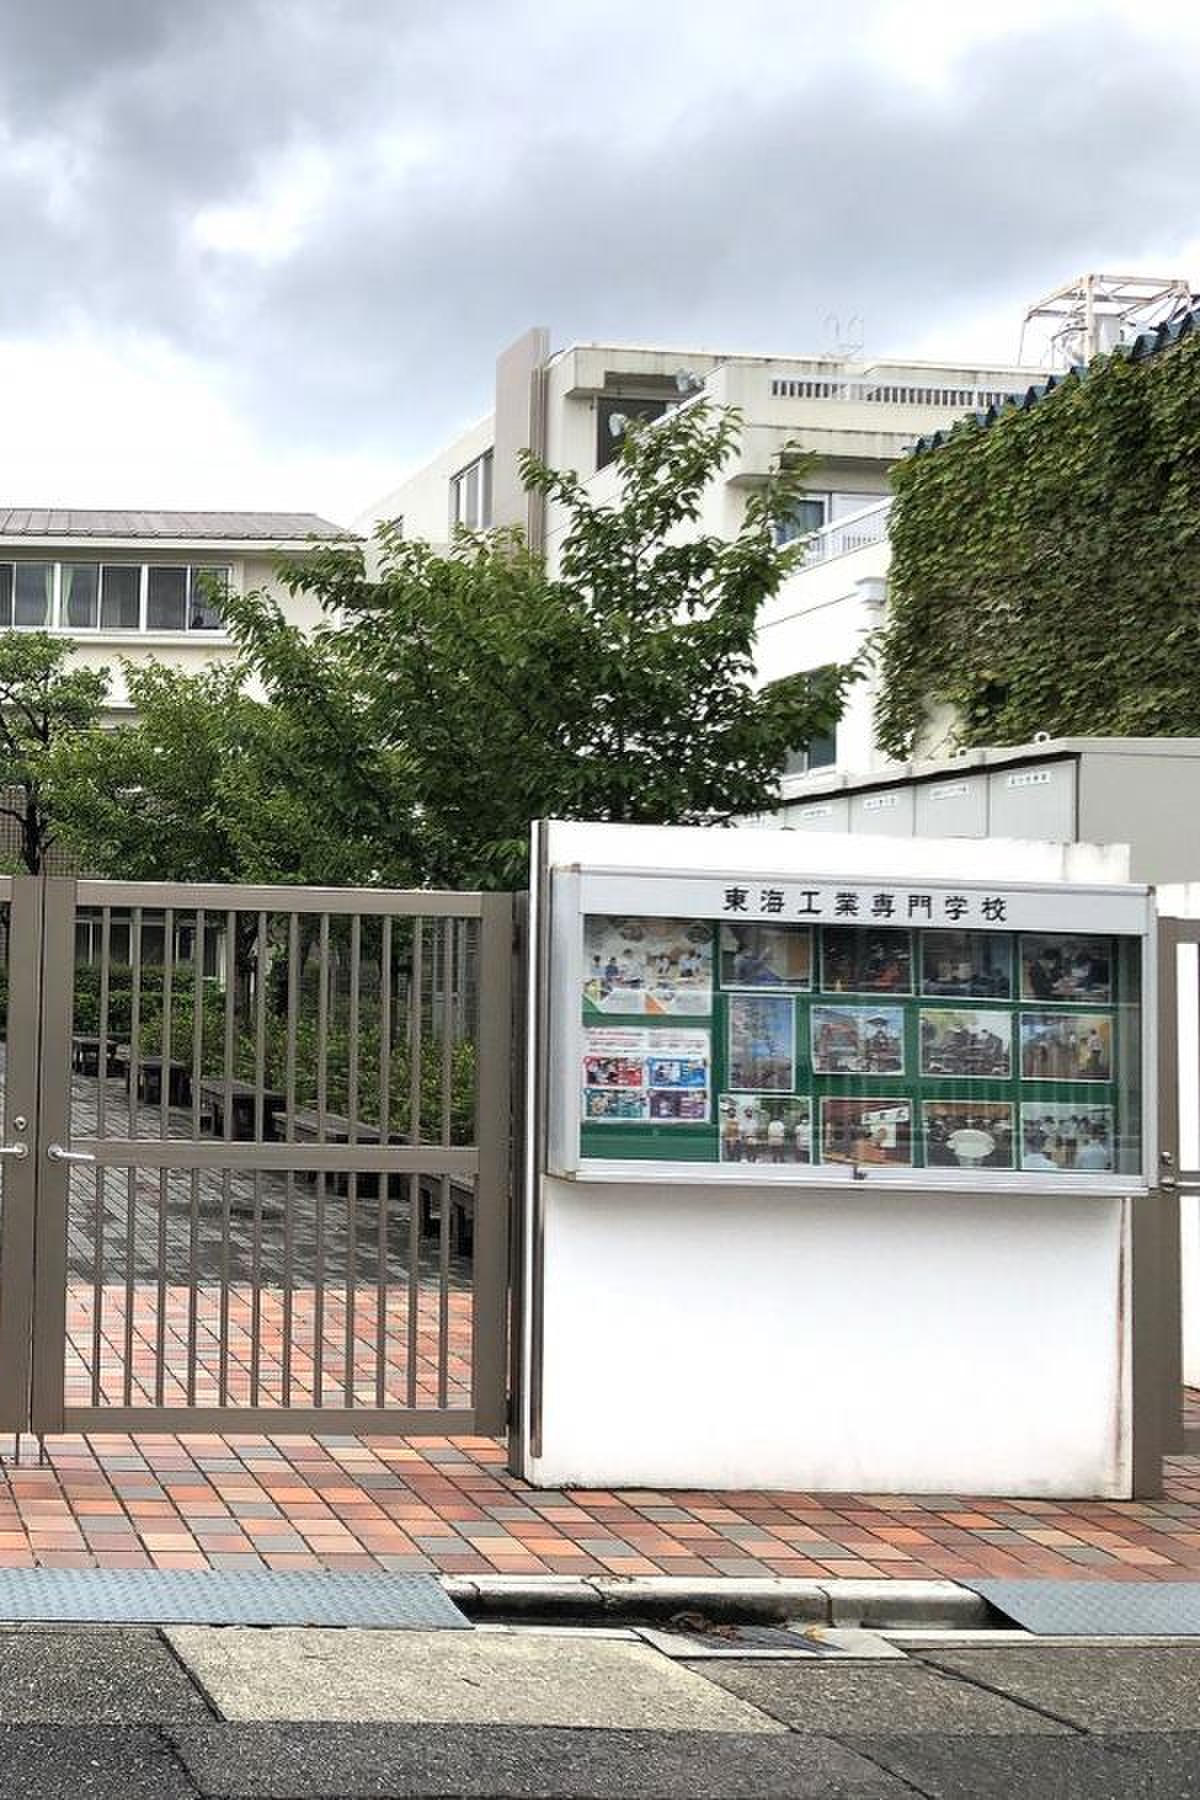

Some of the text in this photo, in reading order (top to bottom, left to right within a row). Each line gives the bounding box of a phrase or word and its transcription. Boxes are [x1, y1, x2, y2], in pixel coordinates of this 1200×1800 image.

[722, 887, 1008, 922] 東海工業専門学校
